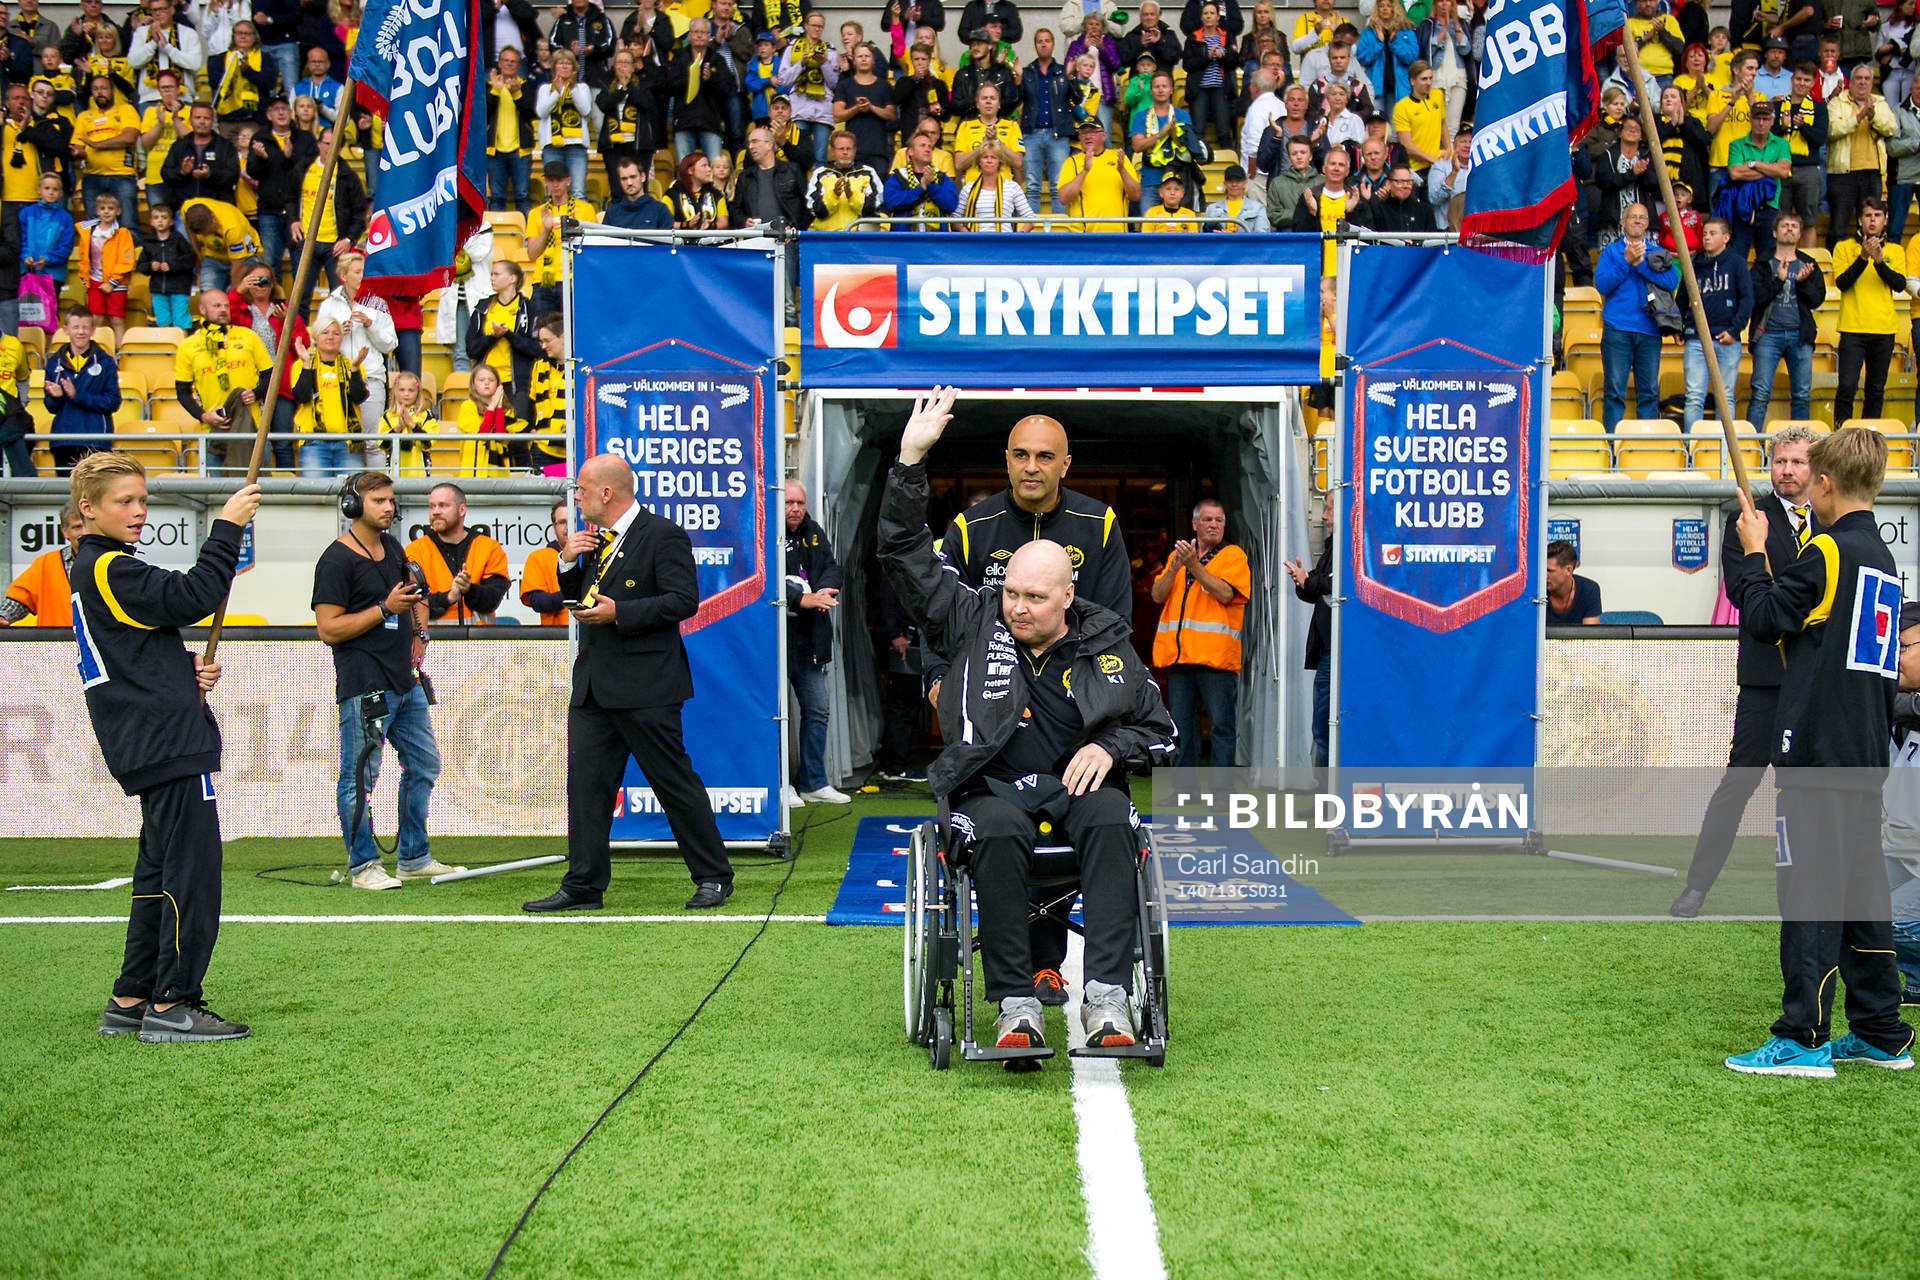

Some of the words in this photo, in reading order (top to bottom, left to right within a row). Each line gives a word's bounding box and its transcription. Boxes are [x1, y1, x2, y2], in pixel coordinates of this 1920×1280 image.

[1479, 3, 1567, 90] UBB
[379, 75, 462, 171] LUBB
[919, 276, 1293, 336] STRYKTIPSET
[633, 379, 694, 392] VÄLKOMMEN
[697, 382, 708, 392] IN
[1402, 378, 1463, 391] VÄLKOMMEN
[1466, 381, 1476, 391] IN
[639, 404, 710, 432] HELA
[1406, 403, 1477, 430] HELA
[606, 437, 743, 465] SVERIGES
[1374, 436, 1508, 463] SVERIGES
[633, 470, 747, 498] TBOLLS
[1370, 468, 1511, 496] FOTBOLLS
[642, 503, 721, 531] UBB
[1395, 501, 1485, 528] KLUBB
[143, 517, 189, 546] cot
[492, 516, 554, 546] tric
[1405, 549, 1494, 563] STRYKTIPSET
[993, 631, 1015, 645] ello
